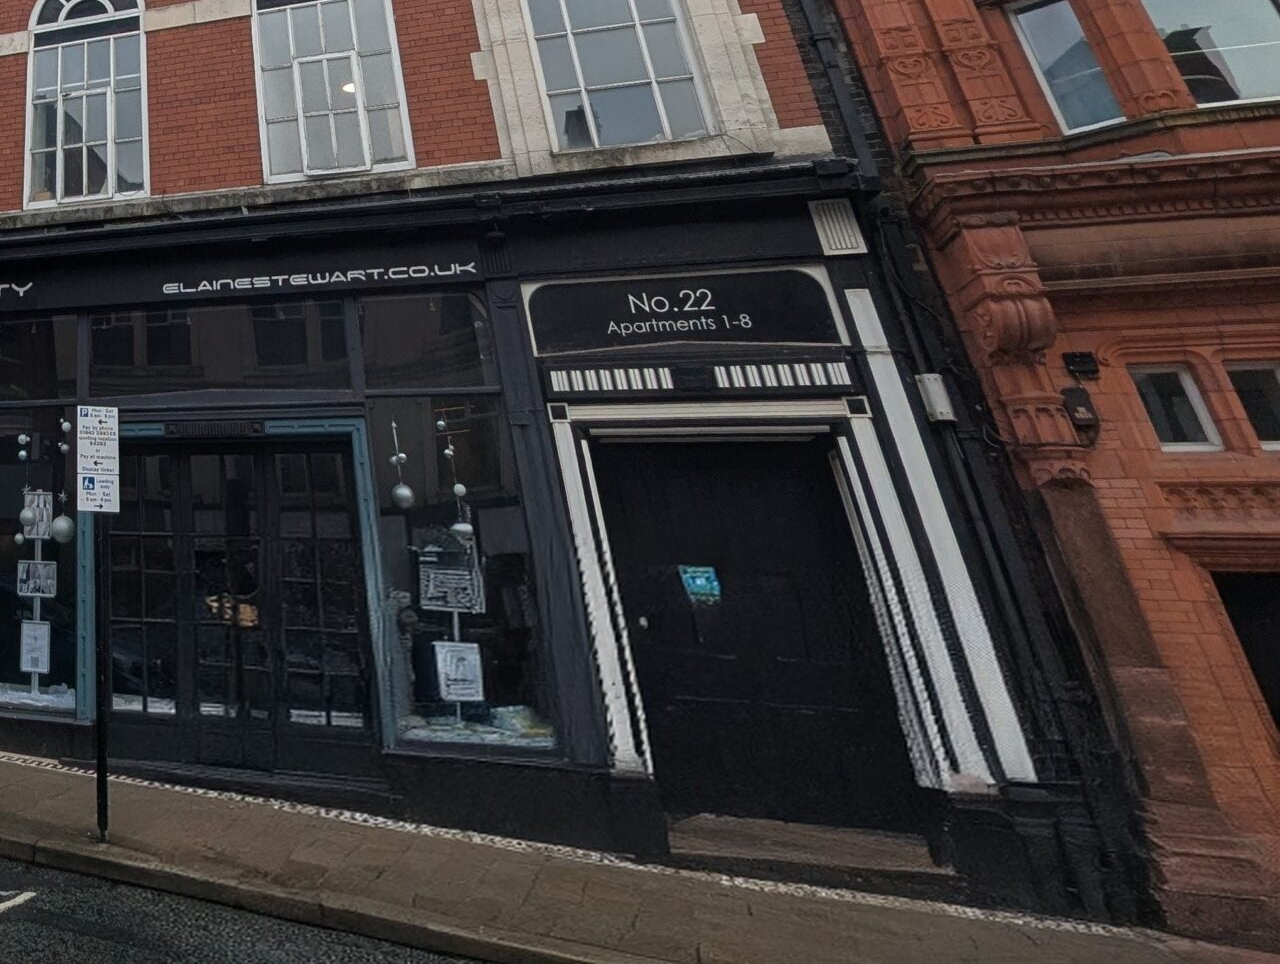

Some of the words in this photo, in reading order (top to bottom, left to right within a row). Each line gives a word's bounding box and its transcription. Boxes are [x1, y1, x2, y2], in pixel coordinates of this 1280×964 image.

[162, 261, 477, 294] ELAINESTEWART.CO.UK
[607, 315, 717, 337] Apartments
[721, 313, 752, 329] 1-8
